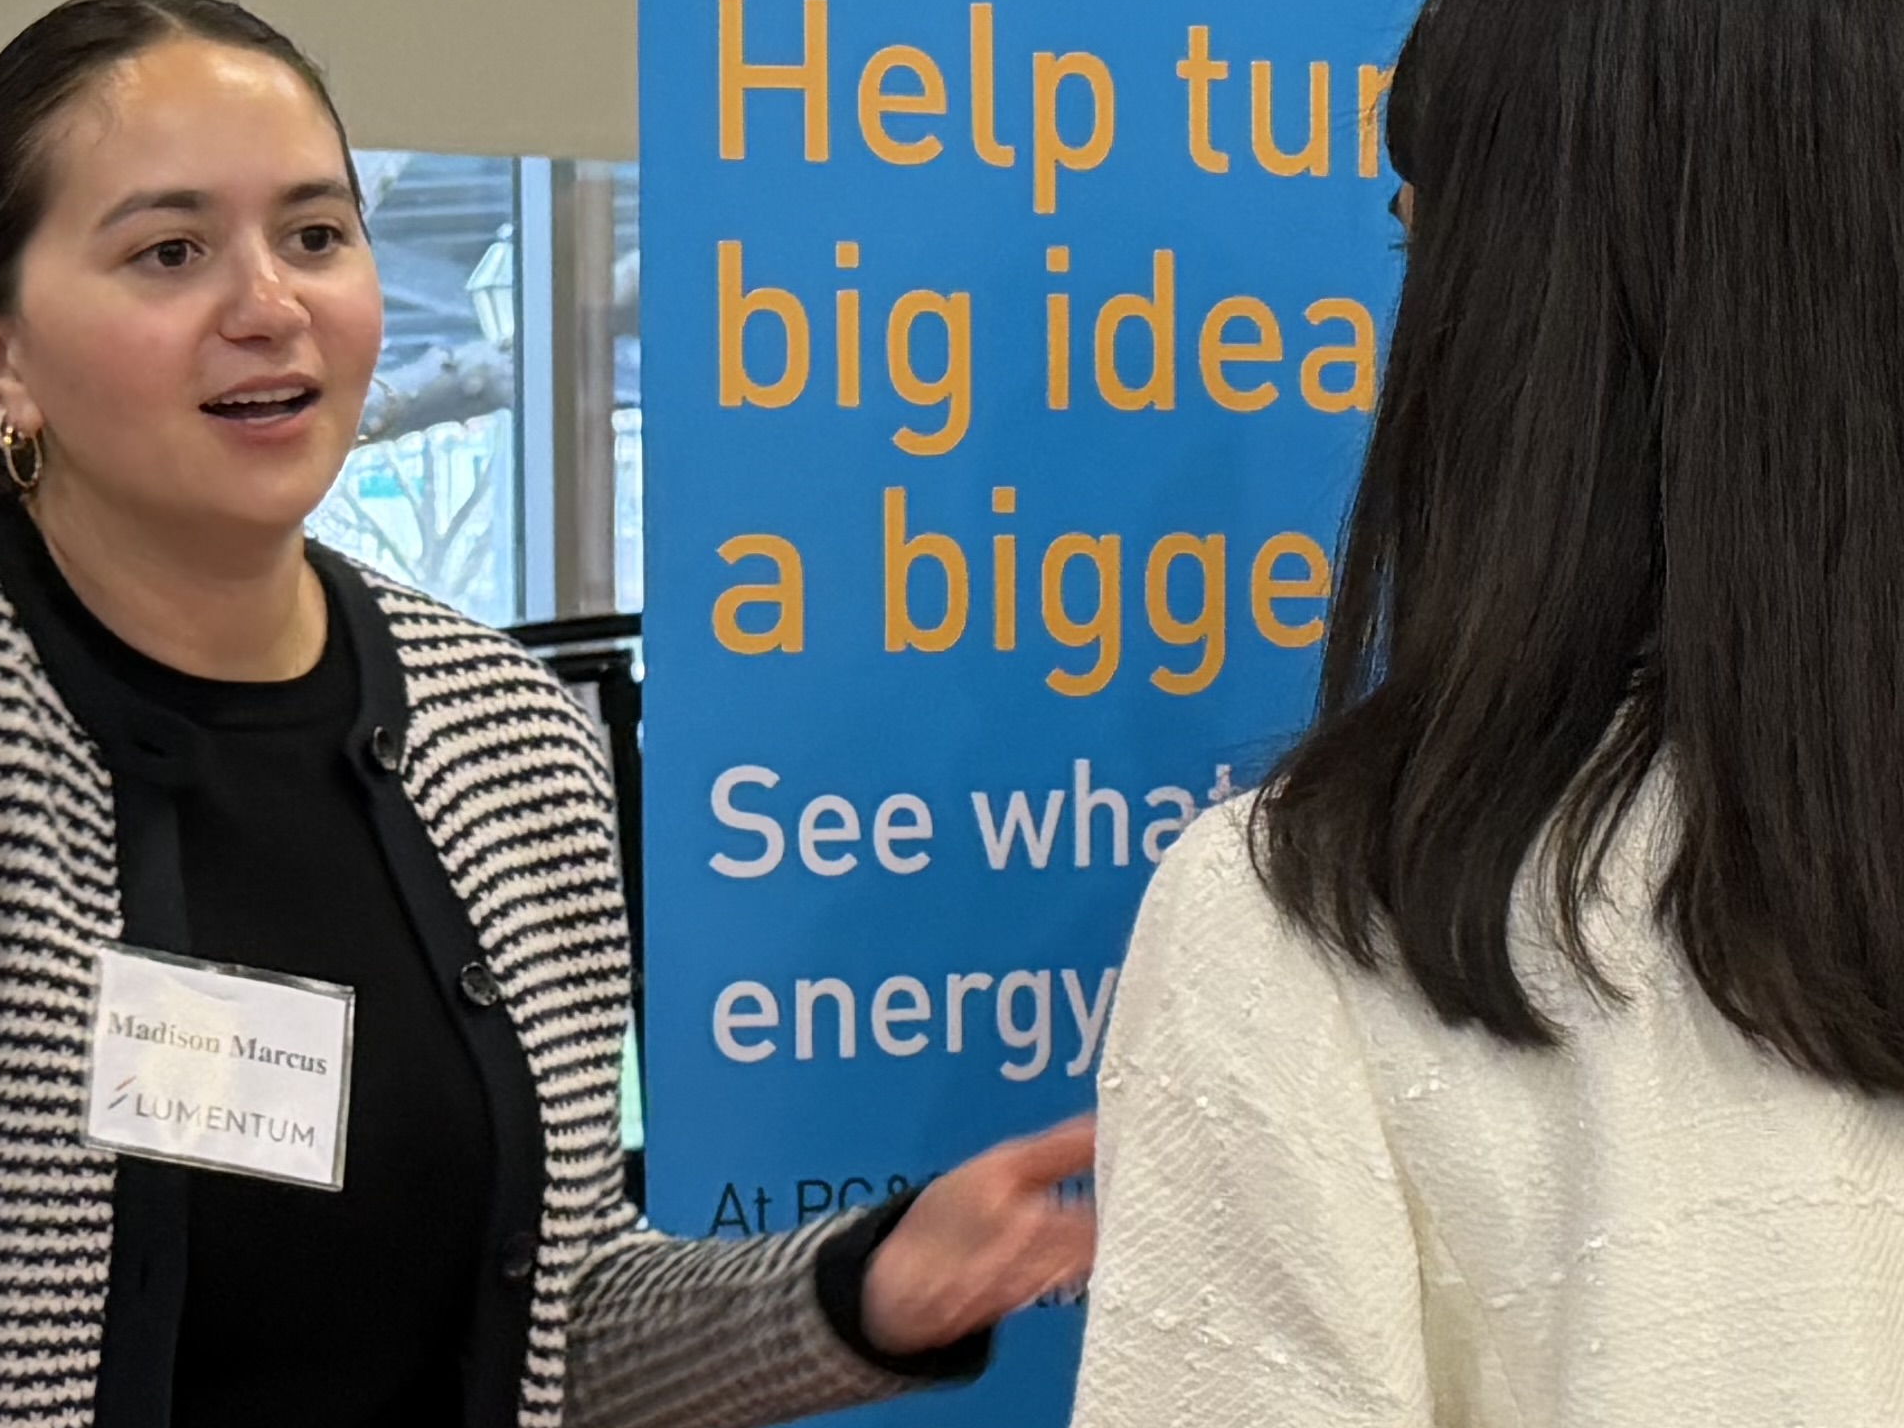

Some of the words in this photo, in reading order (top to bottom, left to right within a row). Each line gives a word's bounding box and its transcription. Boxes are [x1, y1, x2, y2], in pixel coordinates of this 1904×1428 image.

[717, 240, 971, 456] big
[1046, 246, 1376, 413] idea
[712, 533, 804, 655] a
[883, 486, 1332, 696] bigge
[708, 764, 934, 878] See
[108, 1012, 221, 1054] Madison
[230, 1033, 328, 1075] Marcus
[712, 969, 1118, 1081] energy
[135, 1093, 315, 1148] LUMENTUM
[708, 1181, 773, 1236] At
